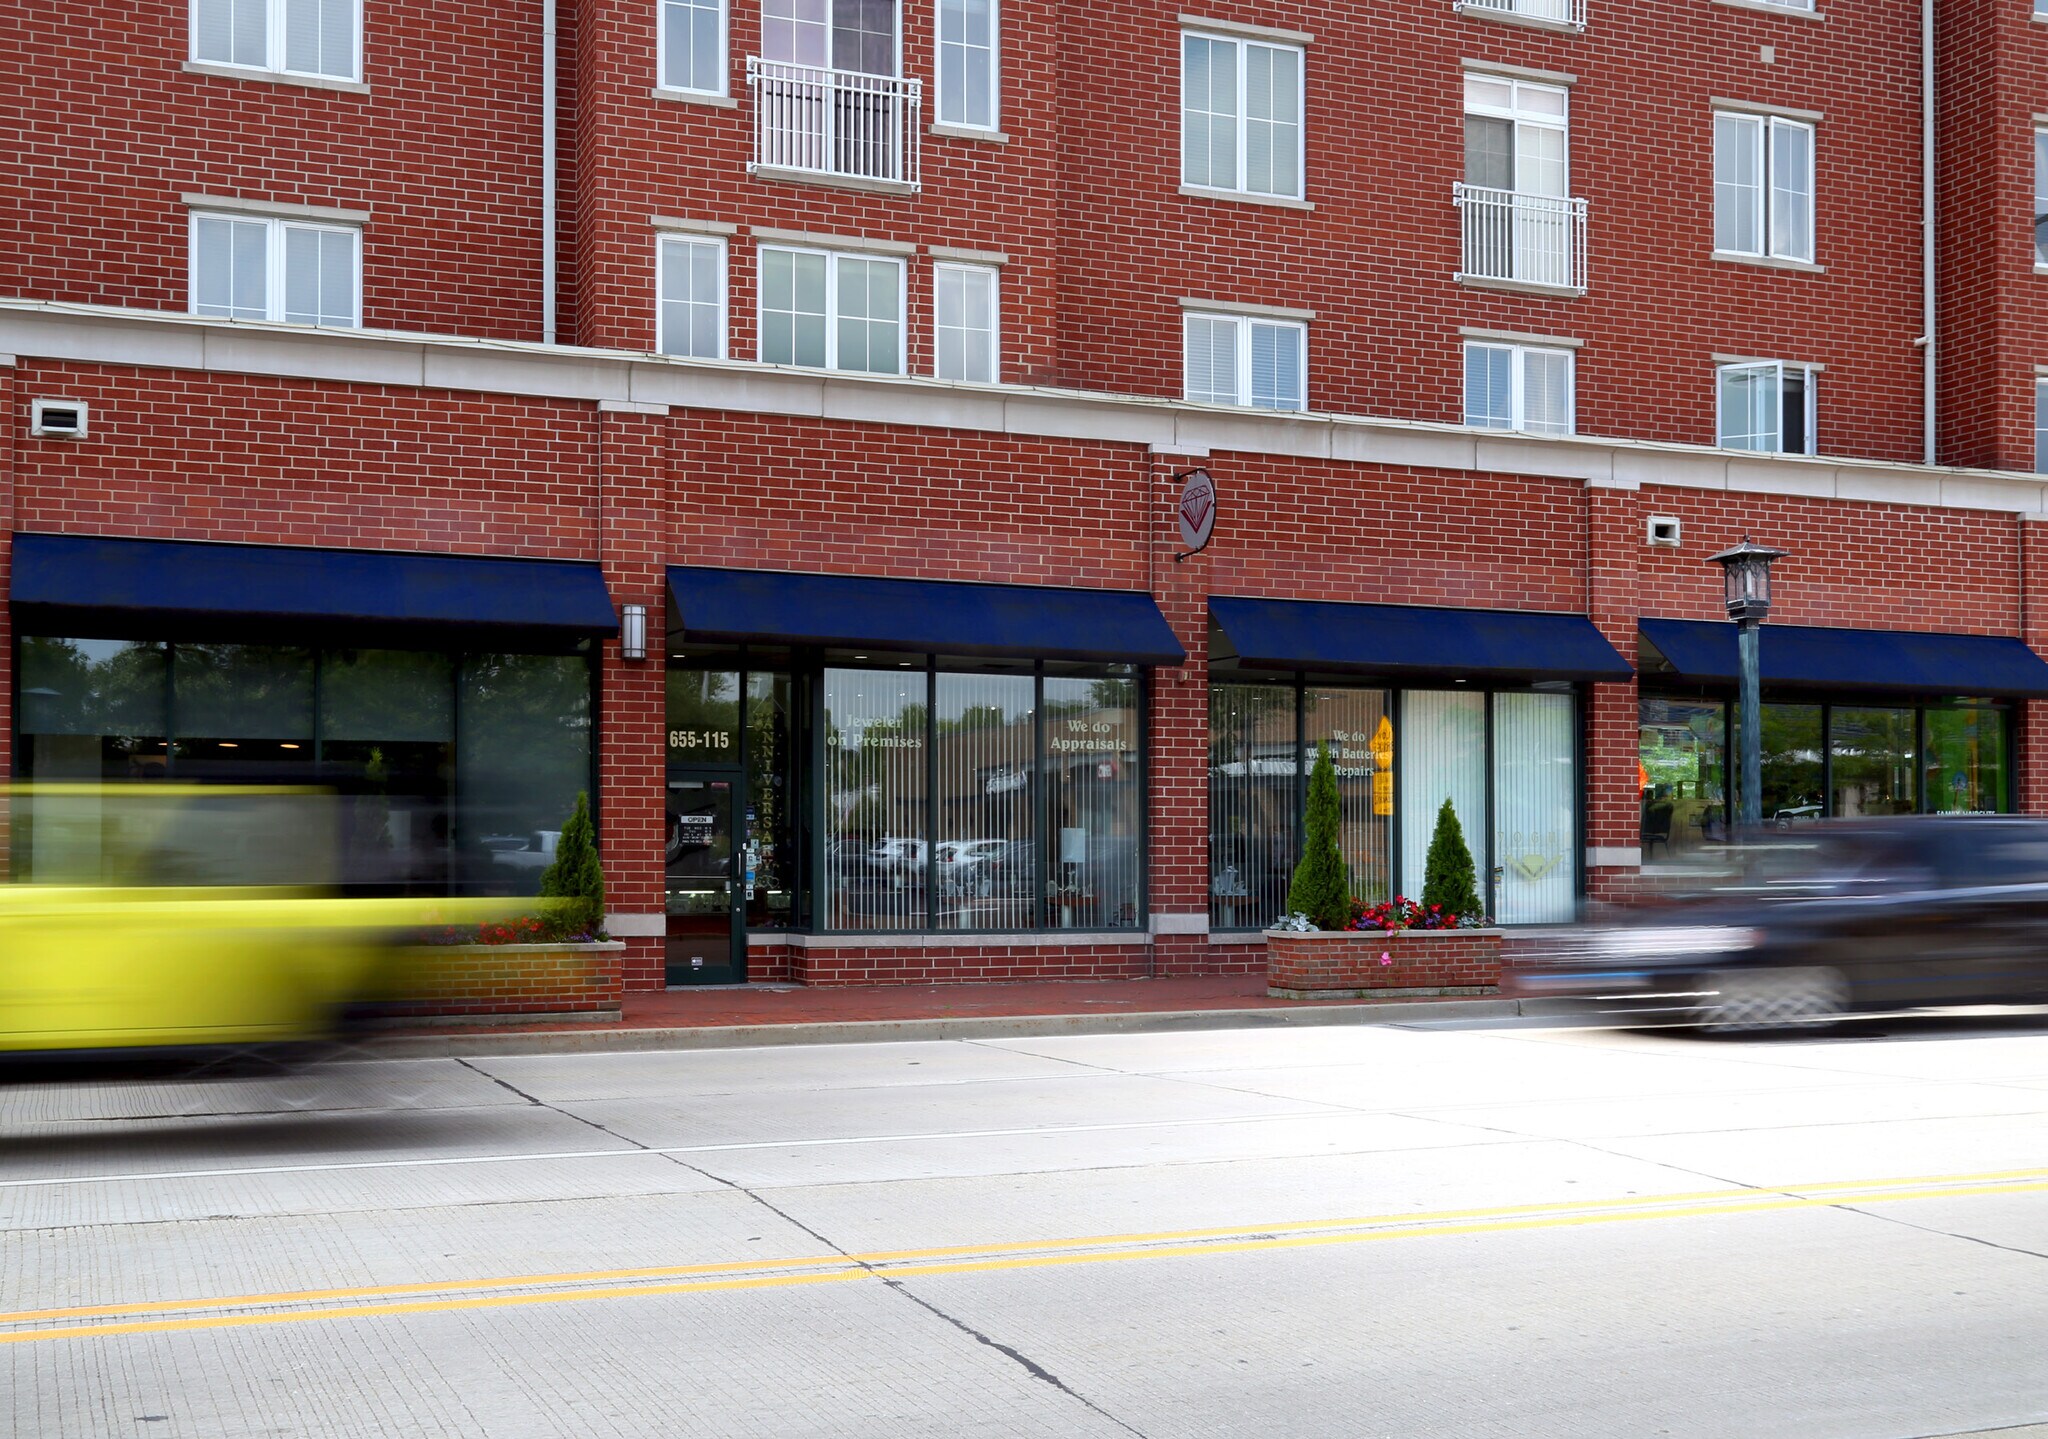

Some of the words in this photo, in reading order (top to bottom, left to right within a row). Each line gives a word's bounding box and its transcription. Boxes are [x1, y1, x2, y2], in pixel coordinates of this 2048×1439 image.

[845, 714, 904, 728] Jeweler
[1067, 720, 1088, 732] We
[1092, 721, 1110, 733] do
[669, 730, 729, 748] 655-115
[827, 735, 847, 746] on
[853, 733, 922, 748] Premises
[1333, 730, 1349, 741] We
[1352, 731, 1366, 742] do
[1050, 736, 1127, 752] Appraisals
[1334, 764, 1375, 778] Repairs
